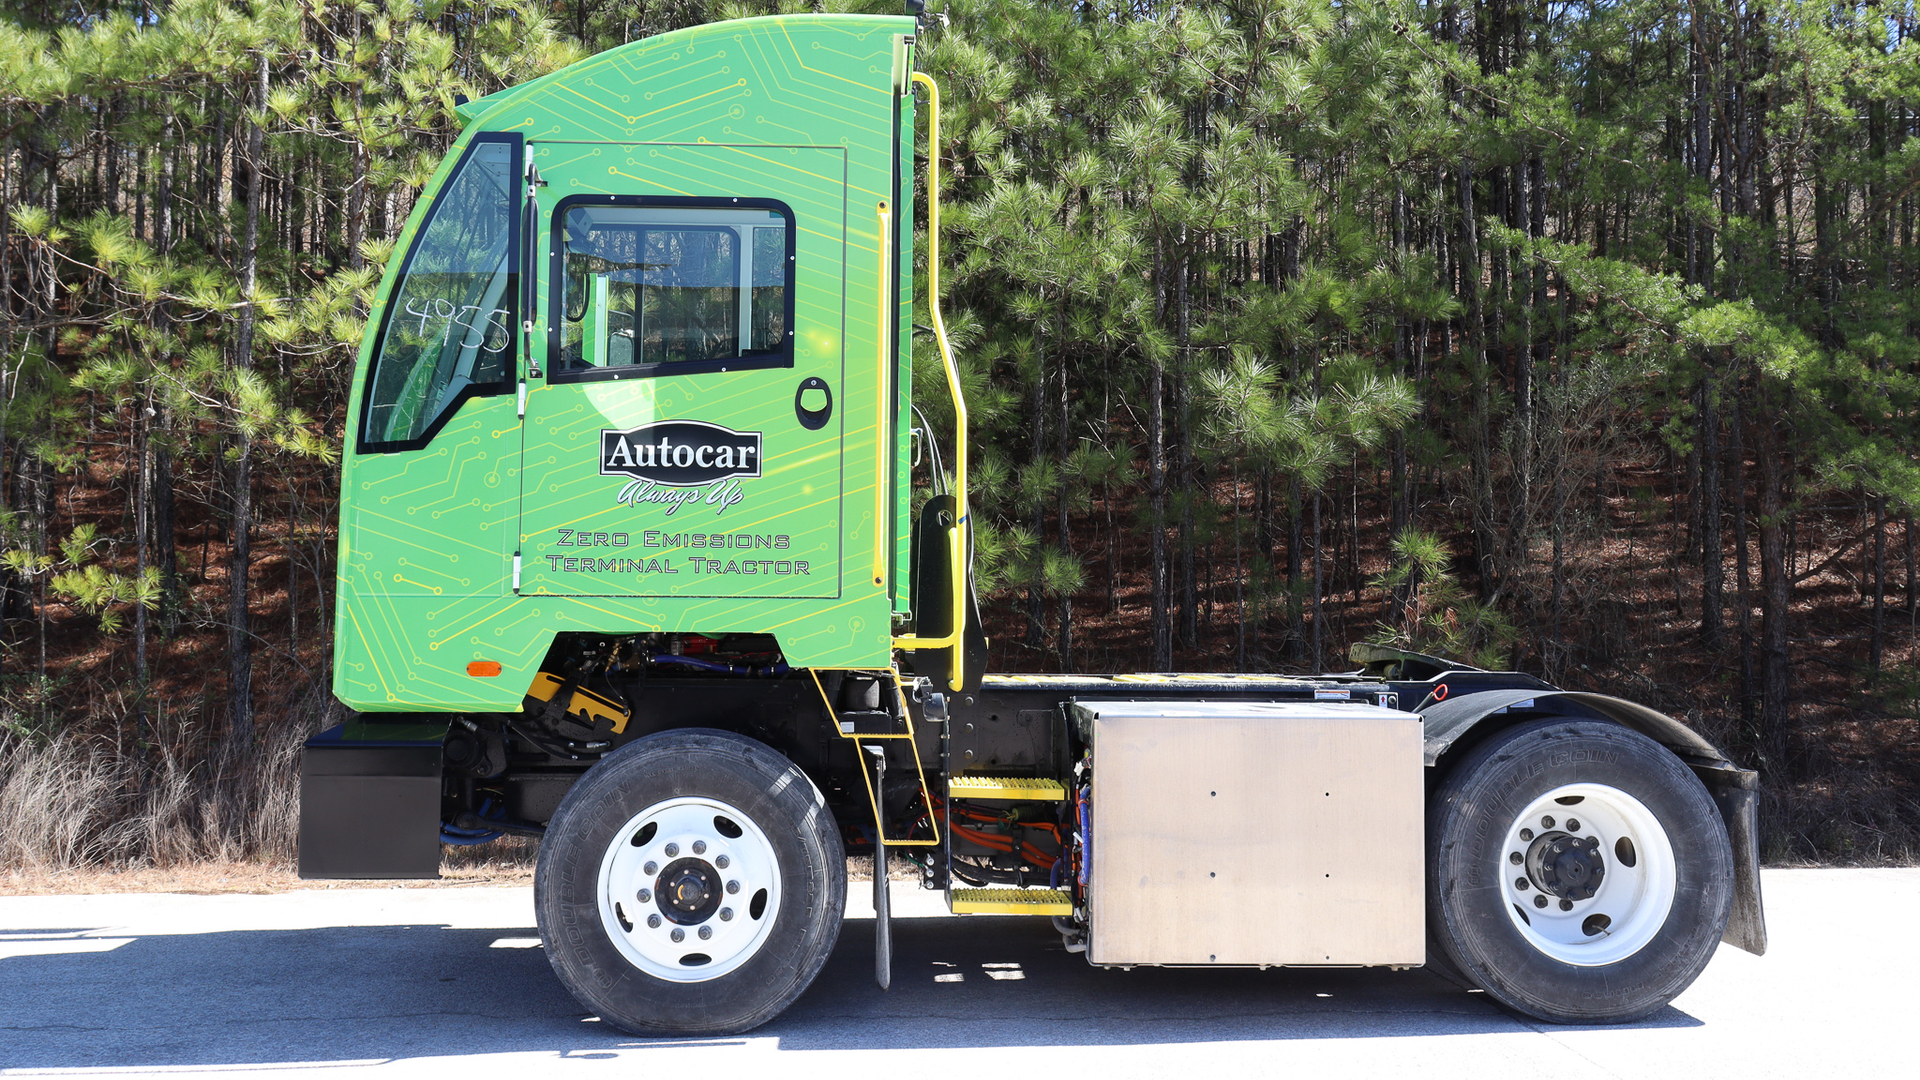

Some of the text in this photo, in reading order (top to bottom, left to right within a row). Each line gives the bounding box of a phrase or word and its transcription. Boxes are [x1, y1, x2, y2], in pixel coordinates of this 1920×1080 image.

[405, 297, 511, 353] 4955
[606, 435, 756, 469] Autocar
[617, 479, 745, 516] Always Up
[556, 529, 791, 550] ZERO EMISSIONS
[545, 554, 811, 576] TERMINAL TRACTOR
[1473, 749, 1620, 860] DOUBLE COIN
[560, 781, 632, 966] DOUBLE COIN
